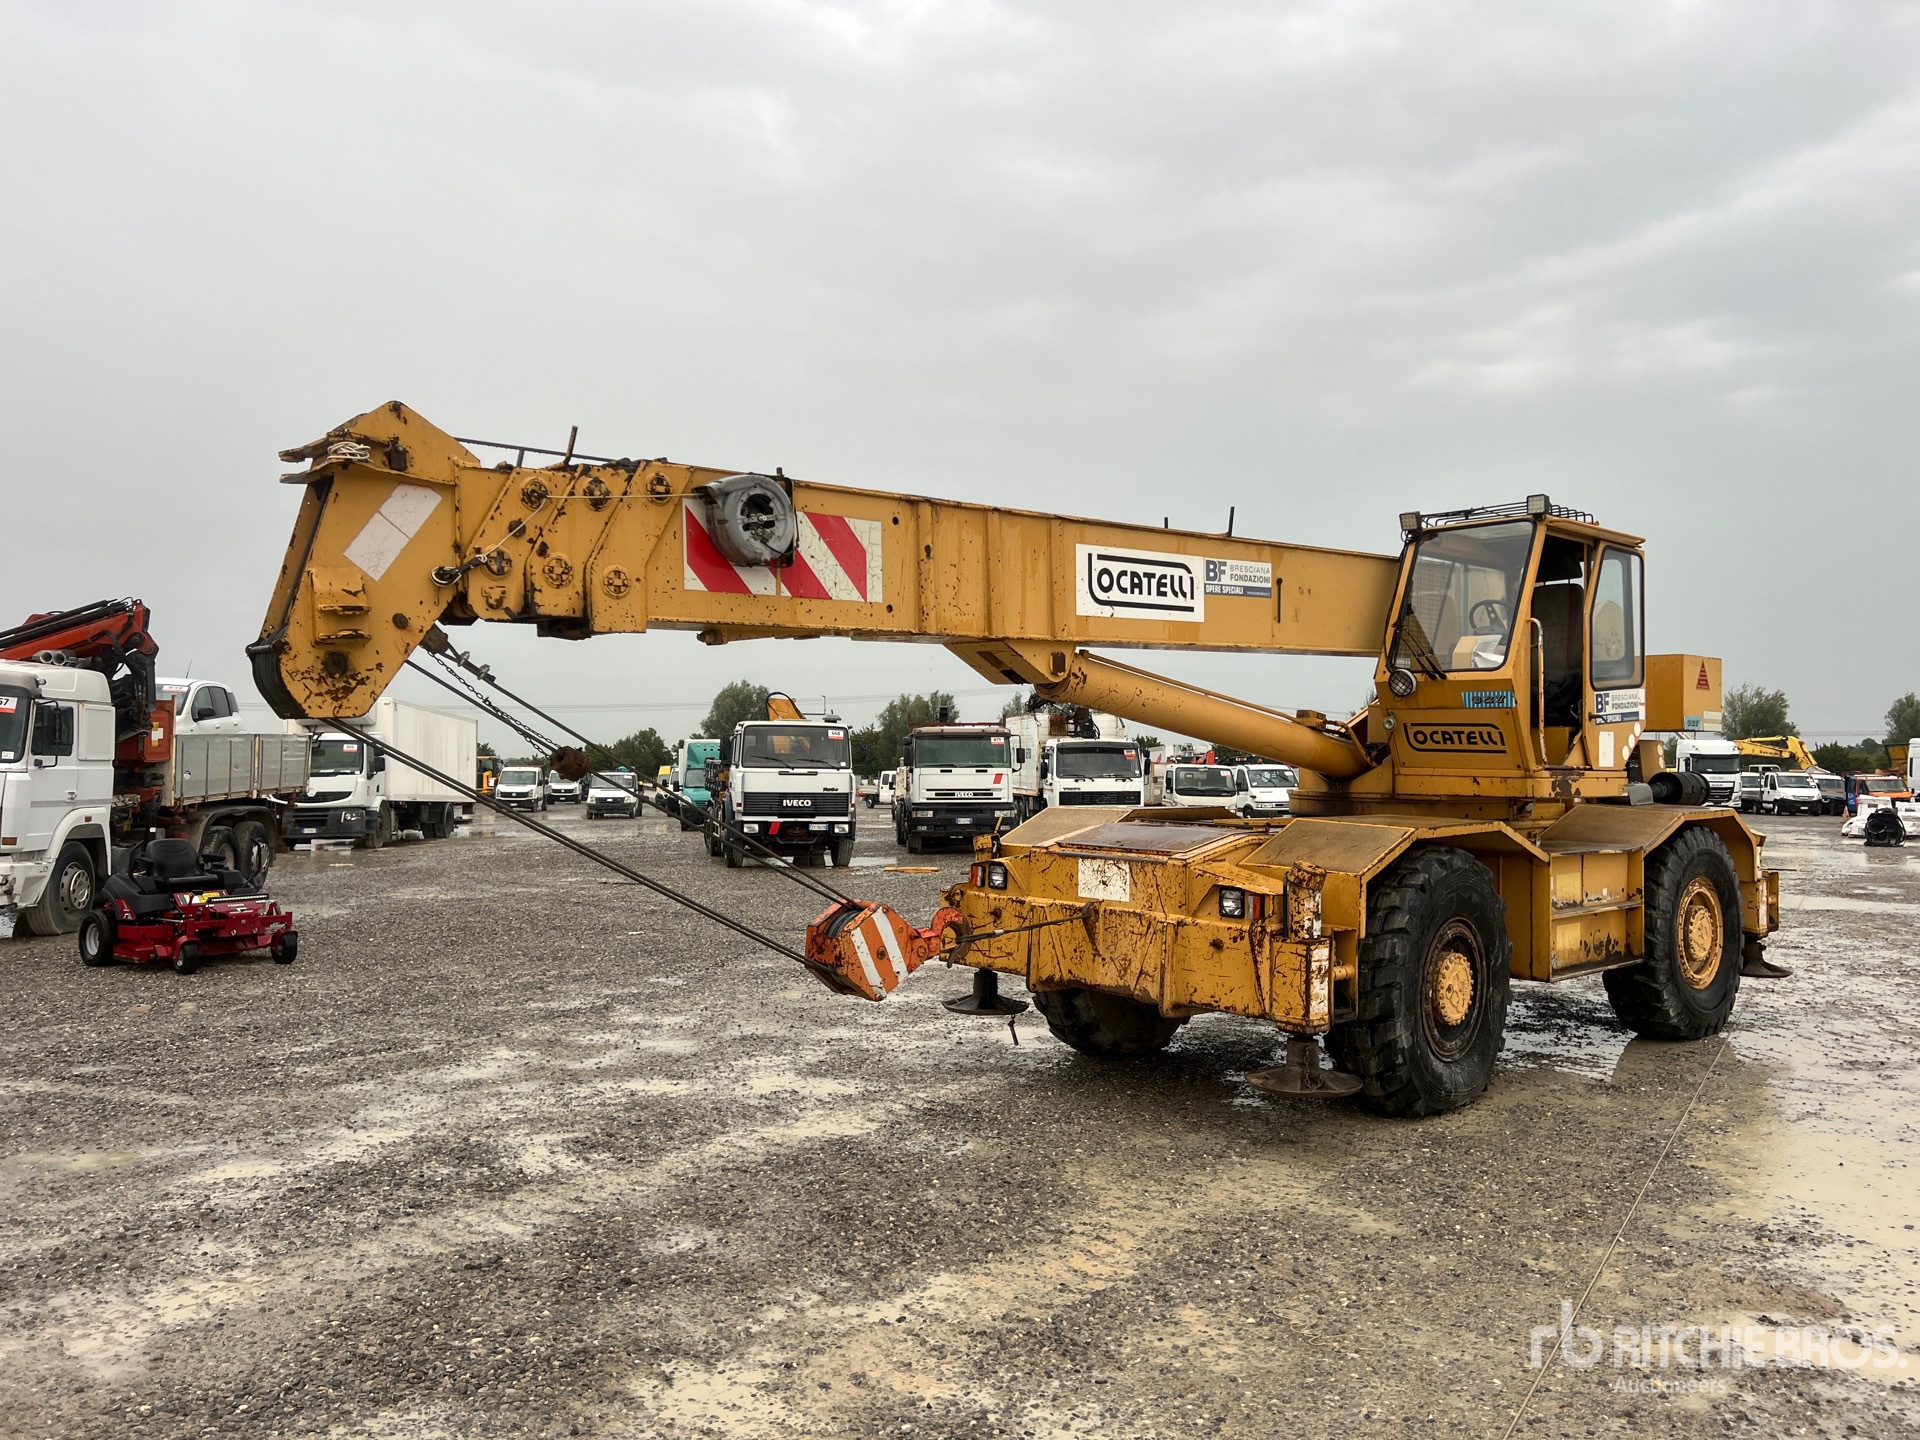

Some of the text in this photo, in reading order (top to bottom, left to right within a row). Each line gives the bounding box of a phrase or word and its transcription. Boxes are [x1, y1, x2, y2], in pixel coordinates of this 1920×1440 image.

[1206, 560, 1227, 582] BF
[1230, 565, 1270, 575] BRESCIANA
[1088, 553, 1195, 612] LOCATELLI
[1230, 574, 1271, 584] FONDAZIONI
[1206, 585, 1221, 593] OPERE
[1222, 586, 1244, 594] SPECIALI
[1611, 693, 1638, 702] BRESCIANA
[1595, 693, 1610, 713] BF
[1403, 723, 1508, 754] LOCATELLI
[783, 799, 812, 807] IVECO
